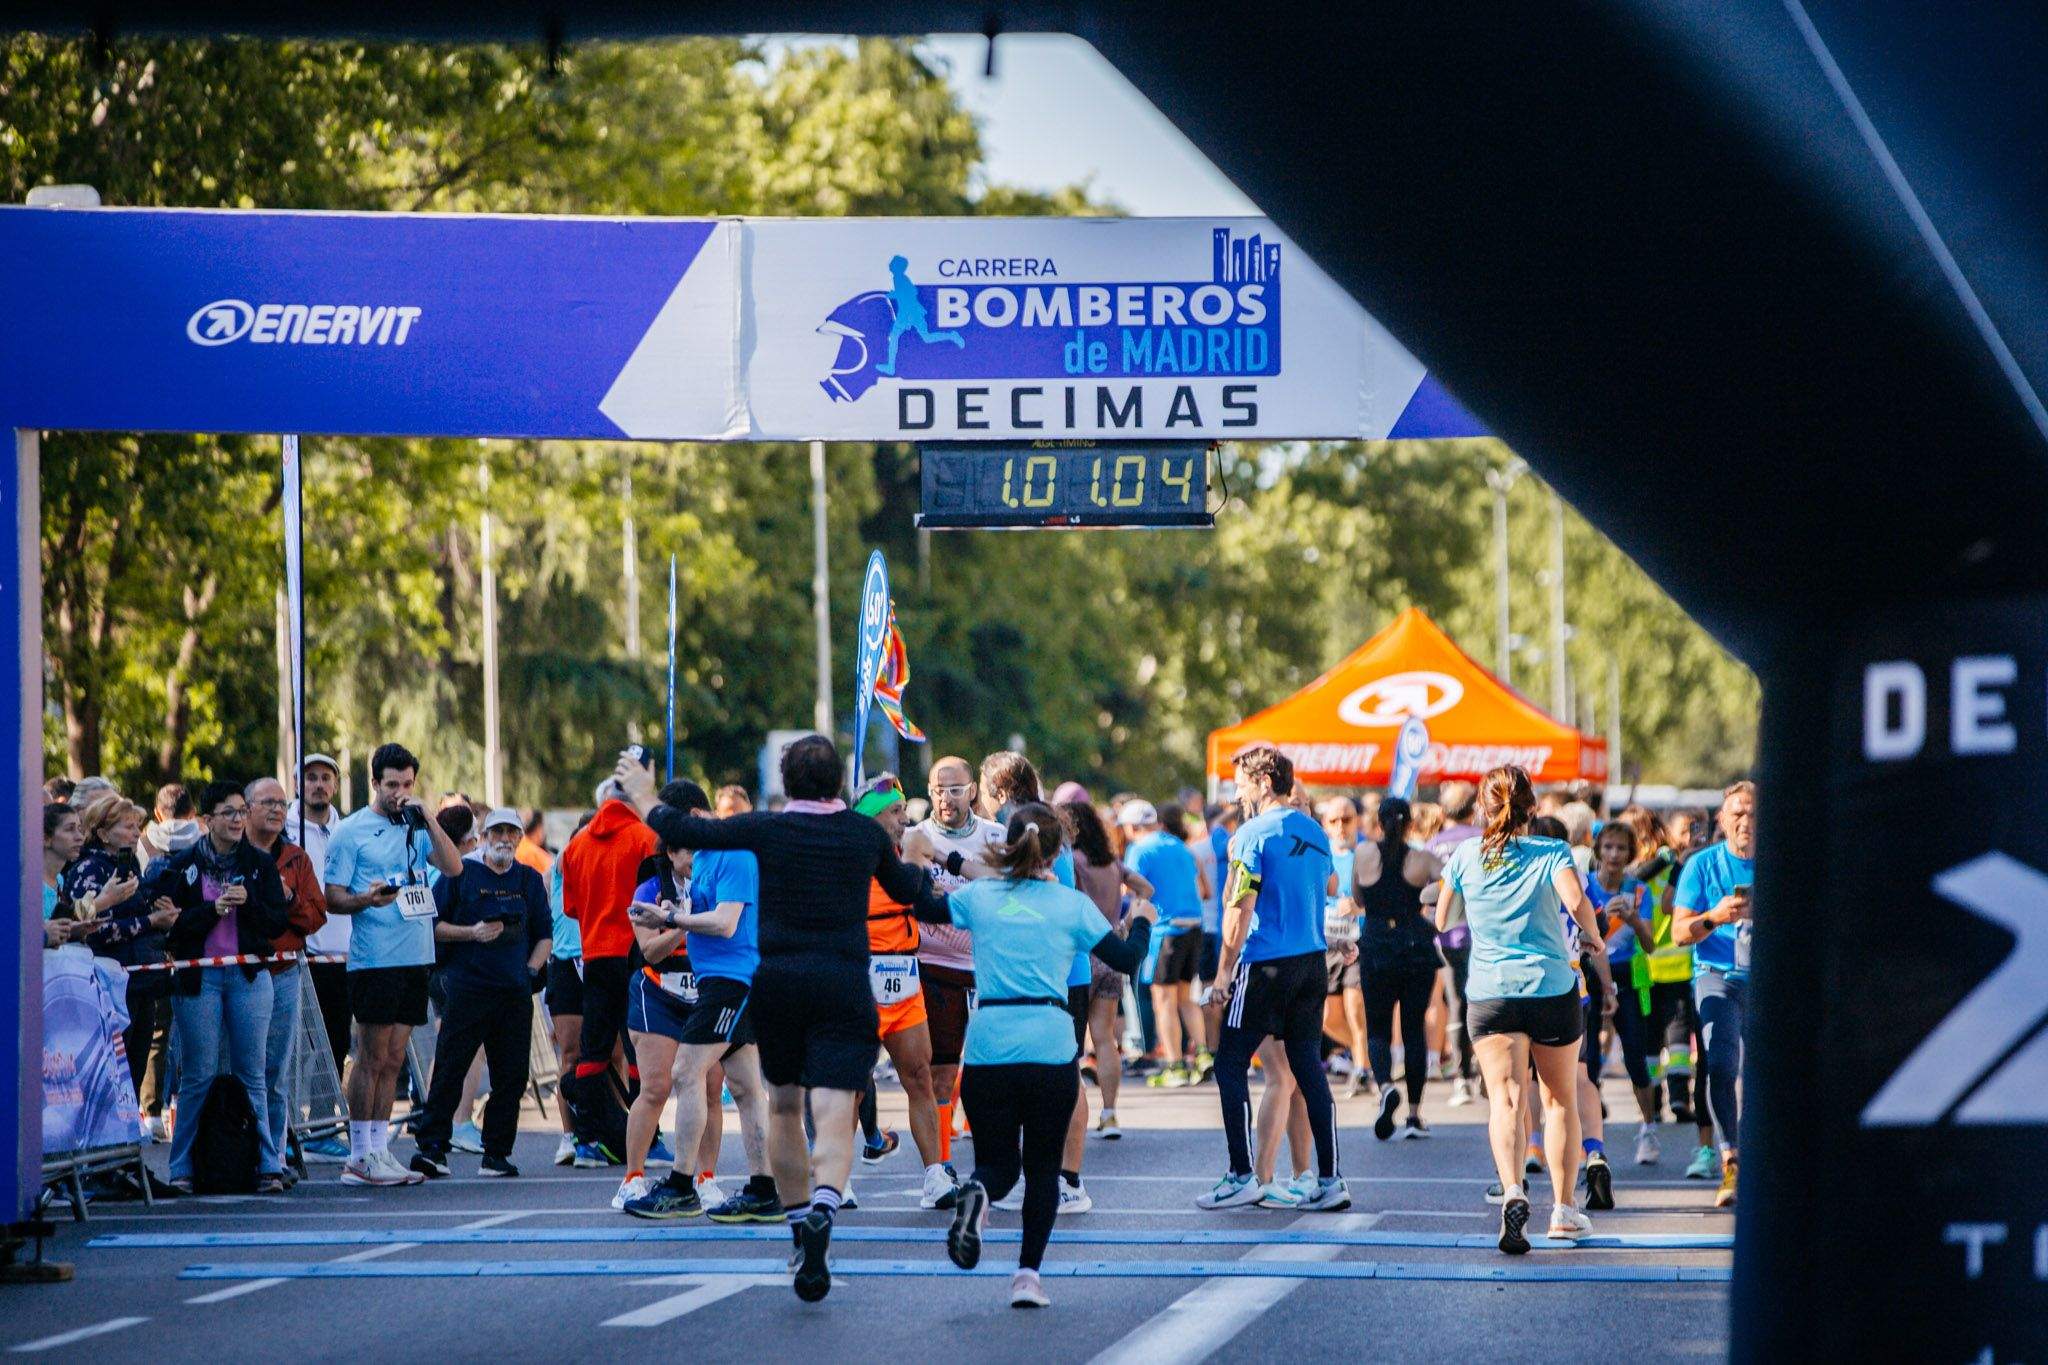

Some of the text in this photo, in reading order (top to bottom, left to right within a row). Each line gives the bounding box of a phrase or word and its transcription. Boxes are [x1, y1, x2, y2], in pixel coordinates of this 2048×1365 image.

[938, 258, 1058, 278] CARRERA
[250, 304, 422, 346] ENERVIT
[937, 285, 1267, 328] BOMBEROS
[1064, 327, 1268, 374] de MADRID
[899, 385, 1259, 429] DECIMAS
[405, 890, 425, 906] 1761
[884, 978, 901, 993] 46
